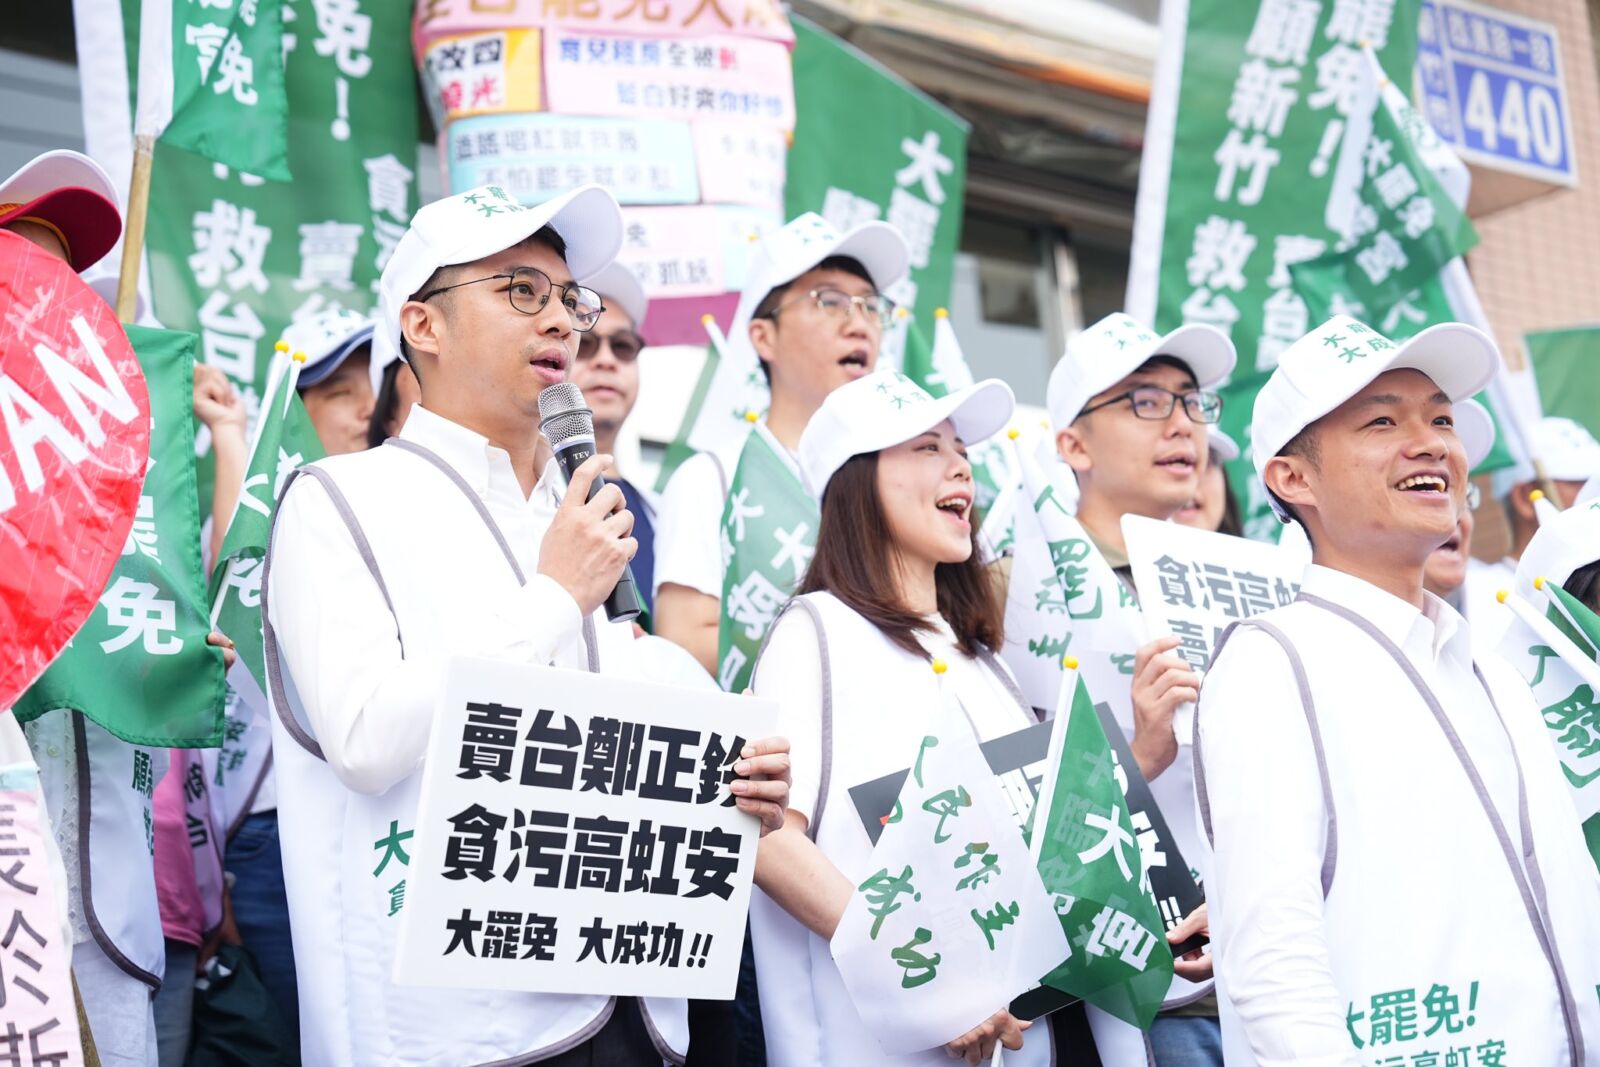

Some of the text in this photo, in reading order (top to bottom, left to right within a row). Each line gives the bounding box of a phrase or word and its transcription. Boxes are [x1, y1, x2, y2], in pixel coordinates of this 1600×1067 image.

[1464, 68, 1563, 168] 440
[0, 315, 140, 516] AN
[440, 802, 743, 901] 貪污高虹安
[442, 908, 714, 969] 大罷免 大成功!!
